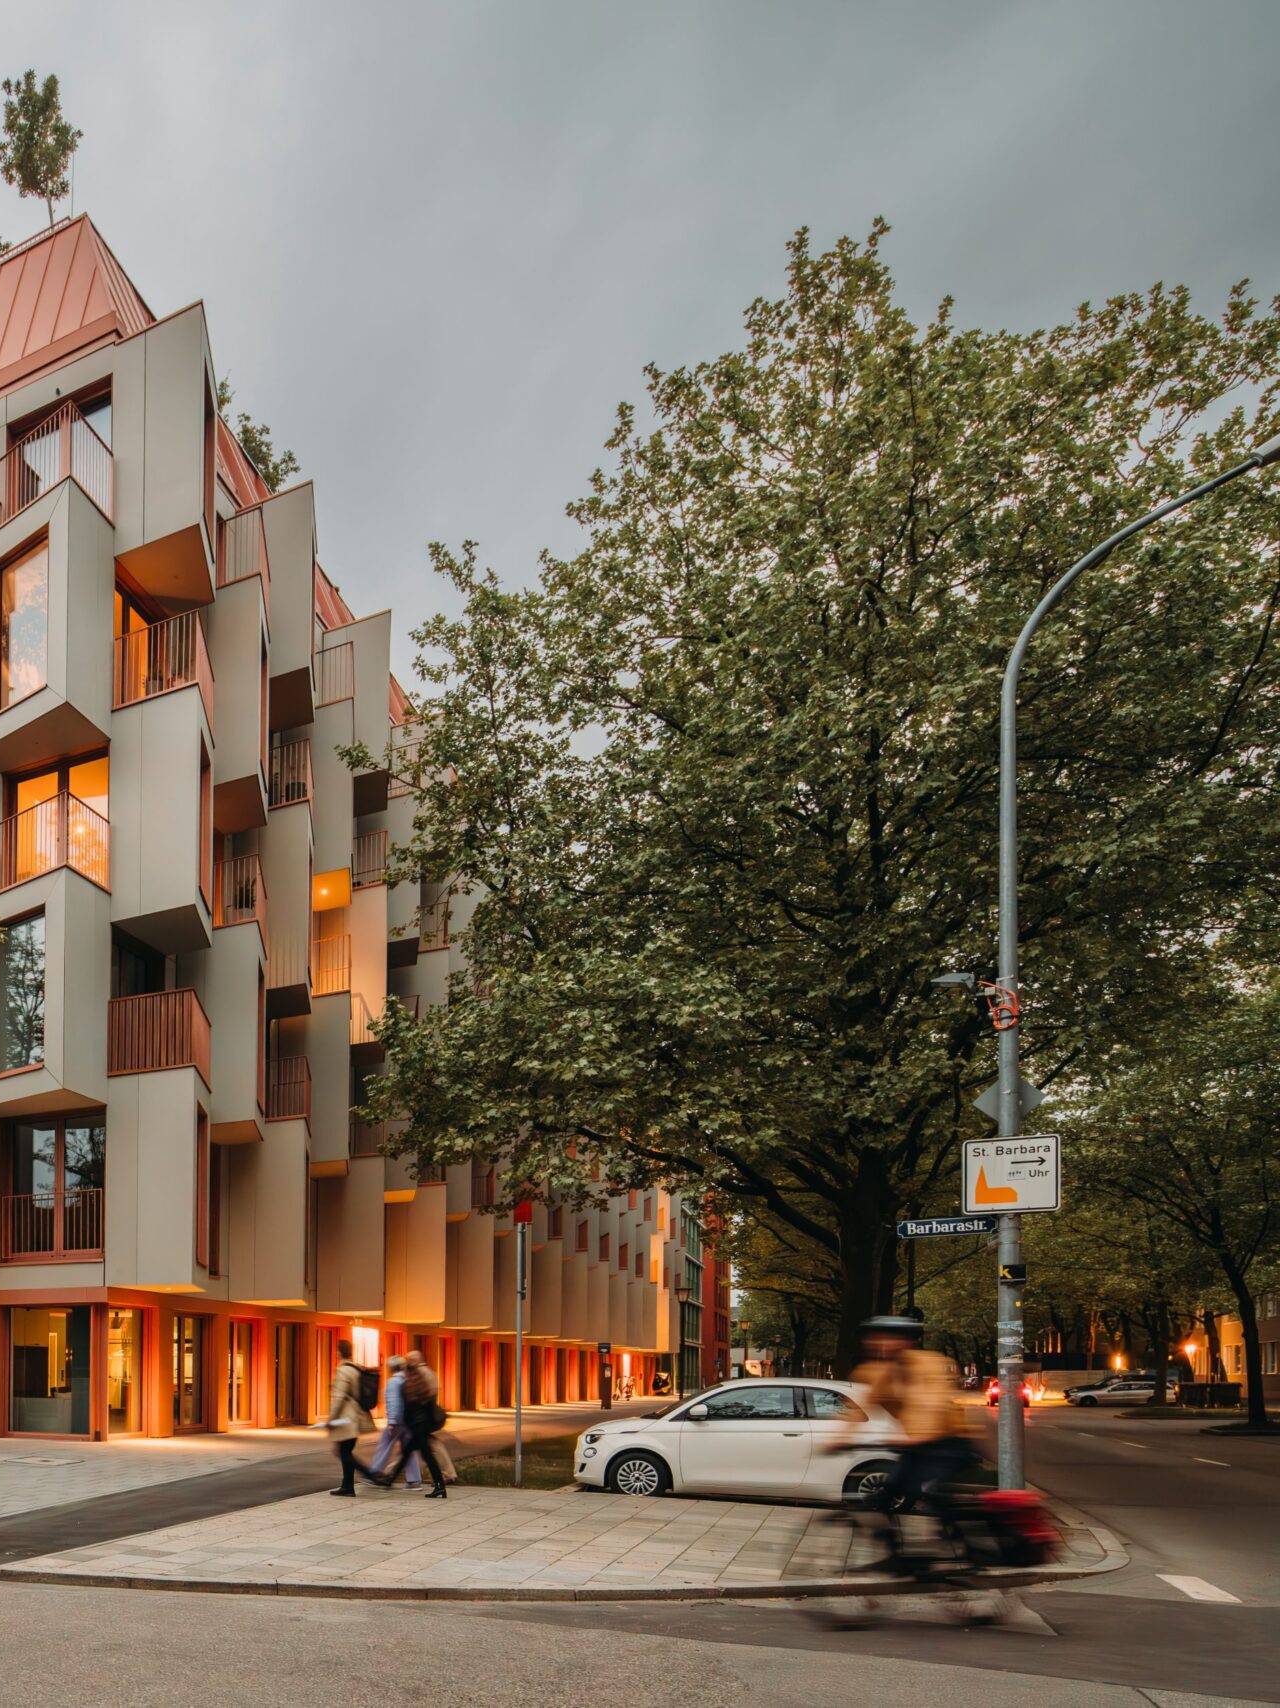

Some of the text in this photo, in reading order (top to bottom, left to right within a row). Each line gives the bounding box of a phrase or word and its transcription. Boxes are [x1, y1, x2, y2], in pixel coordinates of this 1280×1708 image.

[972, 1144, 1051, 1157] St. Barbara
[1028, 1169, 1050, 1178] Uhr
[907, 1219, 988, 1235] Barbarastr.
